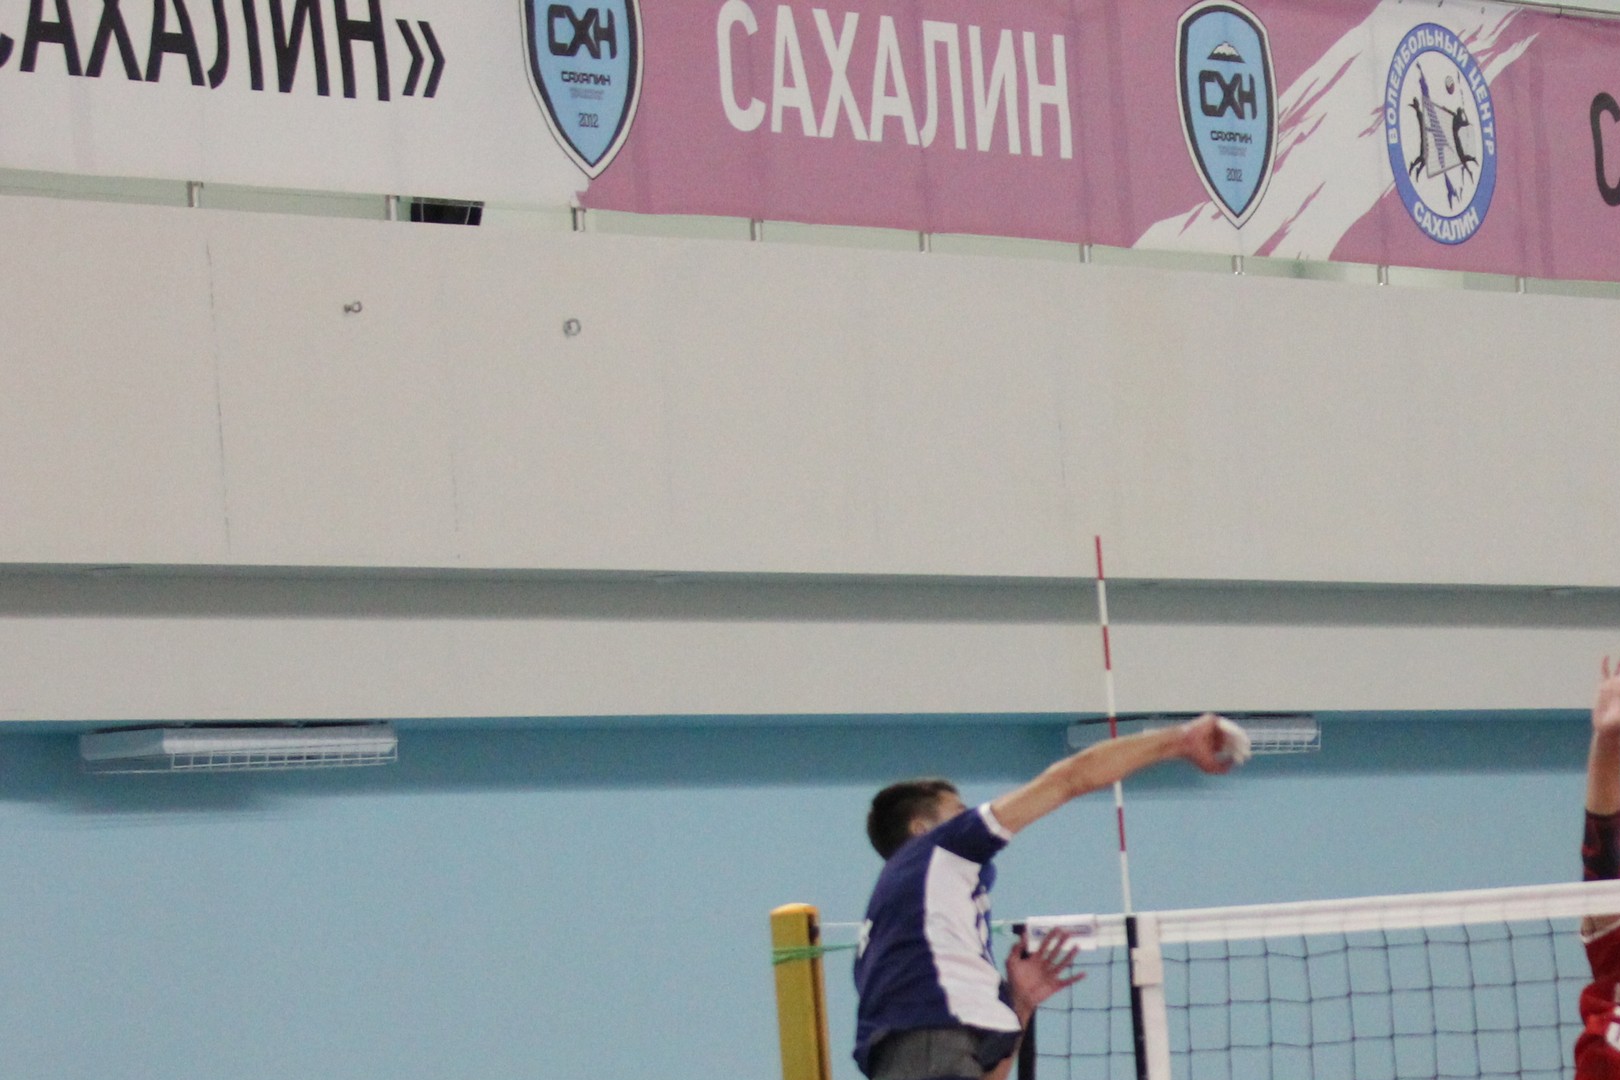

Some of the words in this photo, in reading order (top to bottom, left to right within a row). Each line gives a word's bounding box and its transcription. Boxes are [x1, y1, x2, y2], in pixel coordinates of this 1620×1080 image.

[0, 0, 446, 101] АХАЛИН»
[716, 0, 1073, 159] САХАЛИН
[1467, 66, 1495, 156] ЦЕНТР
[1413, 201, 1480, 241] САХАЛИН
